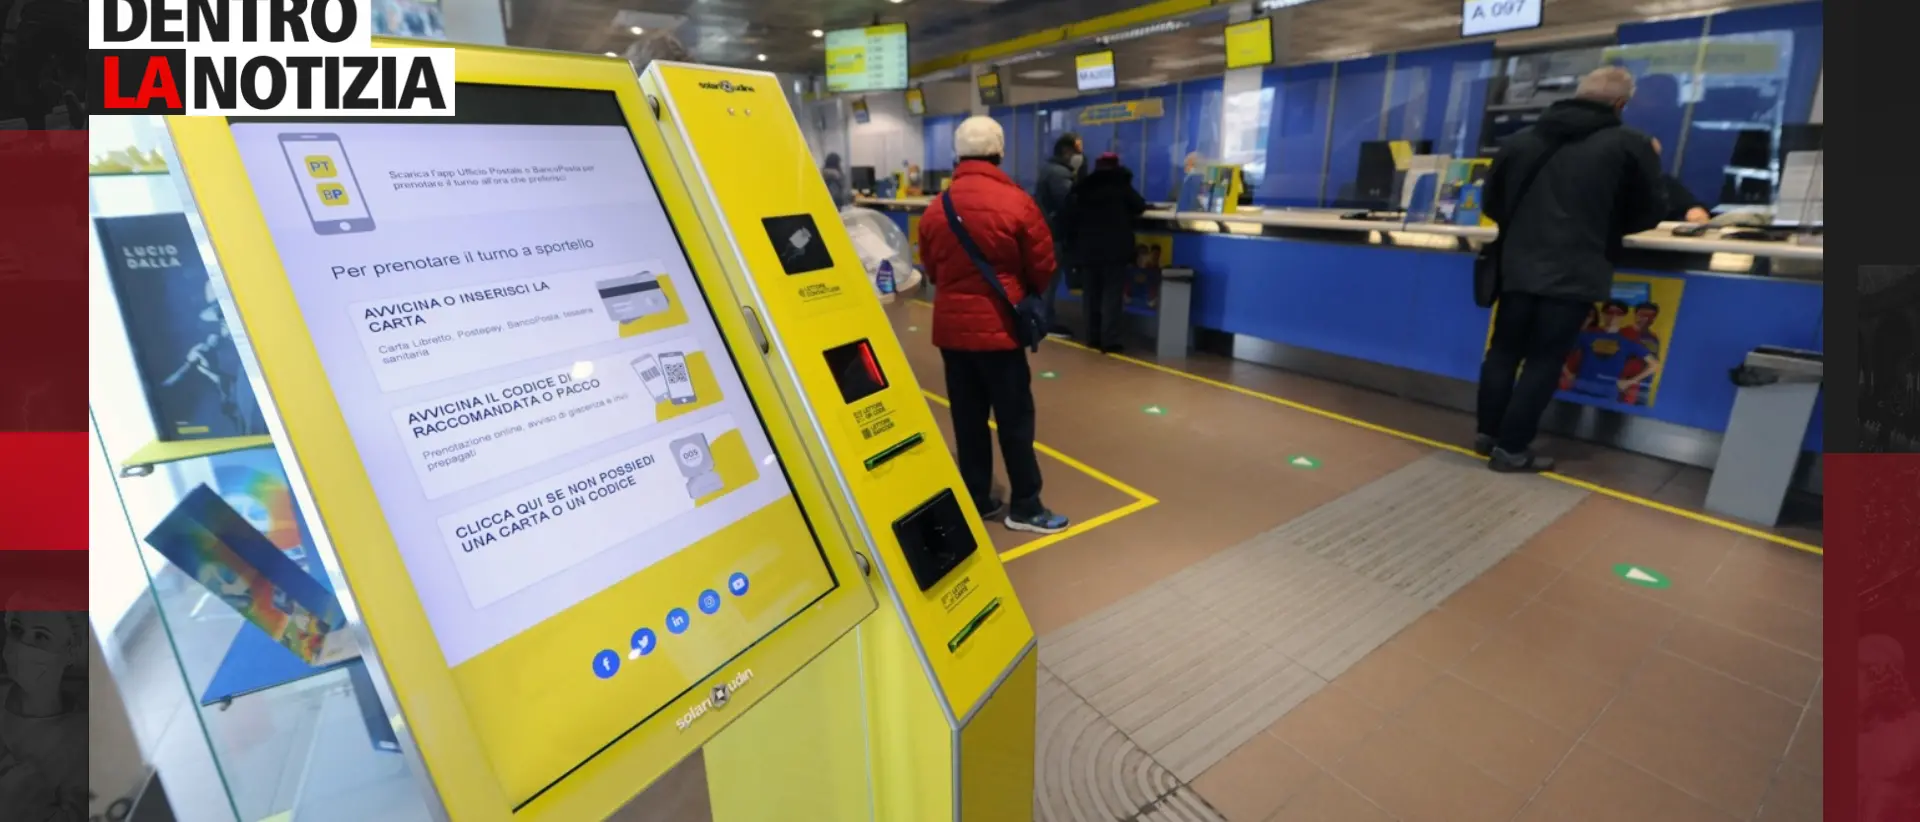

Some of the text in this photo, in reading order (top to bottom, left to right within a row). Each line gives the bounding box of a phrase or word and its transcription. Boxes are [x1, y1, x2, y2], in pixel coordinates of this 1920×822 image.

[1472, 5, 1485, 20] A
[309, 160, 330, 173] PT
[388, 169, 430, 180] Scarica
[458, 165, 487, 177] Ufficio
[489, 165, 523, 176] Postale
[532, 164, 581, 174] BancoPosta
[582, 164, 595, 173] per
[393, 178, 443, 190] prenotare
[446, 178, 452, 187] il
[454, 177, 479, 187] turno
[511, 175, 527, 184] che
[528, 174, 567, 185] preferisci
[322, 188, 343, 201] BP
[122, 244, 178, 258] LUCIO
[331, 238, 594, 280] Per prenotare il turno a sportello
[126, 257, 182, 270] DALLA
[364, 281, 551, 320] AVVICINA O INSERISCI LA
[368, 314, 427, 333] CARTA
[378, 342, 410, 355] Carta
[412, 334, 454, 349] Libretto,
[382, 348, 430, 365] sanitaria
[408, 371, 572, 426] AVVICINA IL CODICE DI
[412, 378, 600, 439] RACCOMANDATA O PACCO
[422, 433, 492, 460] Prenotazione
[493, 423, 526, 440] online,
[528, 414, 558, 429] avviso
[558, 410, 567, 419] di
[569, 400, 606, 418] giacenza
[427, 449, 477, 472] prepagati
[455, 454, 656, 540] CLICCA QUI SE NON POSSIEDI
[461, 475, 637, 554] UNA CARTA O UN CODICE
